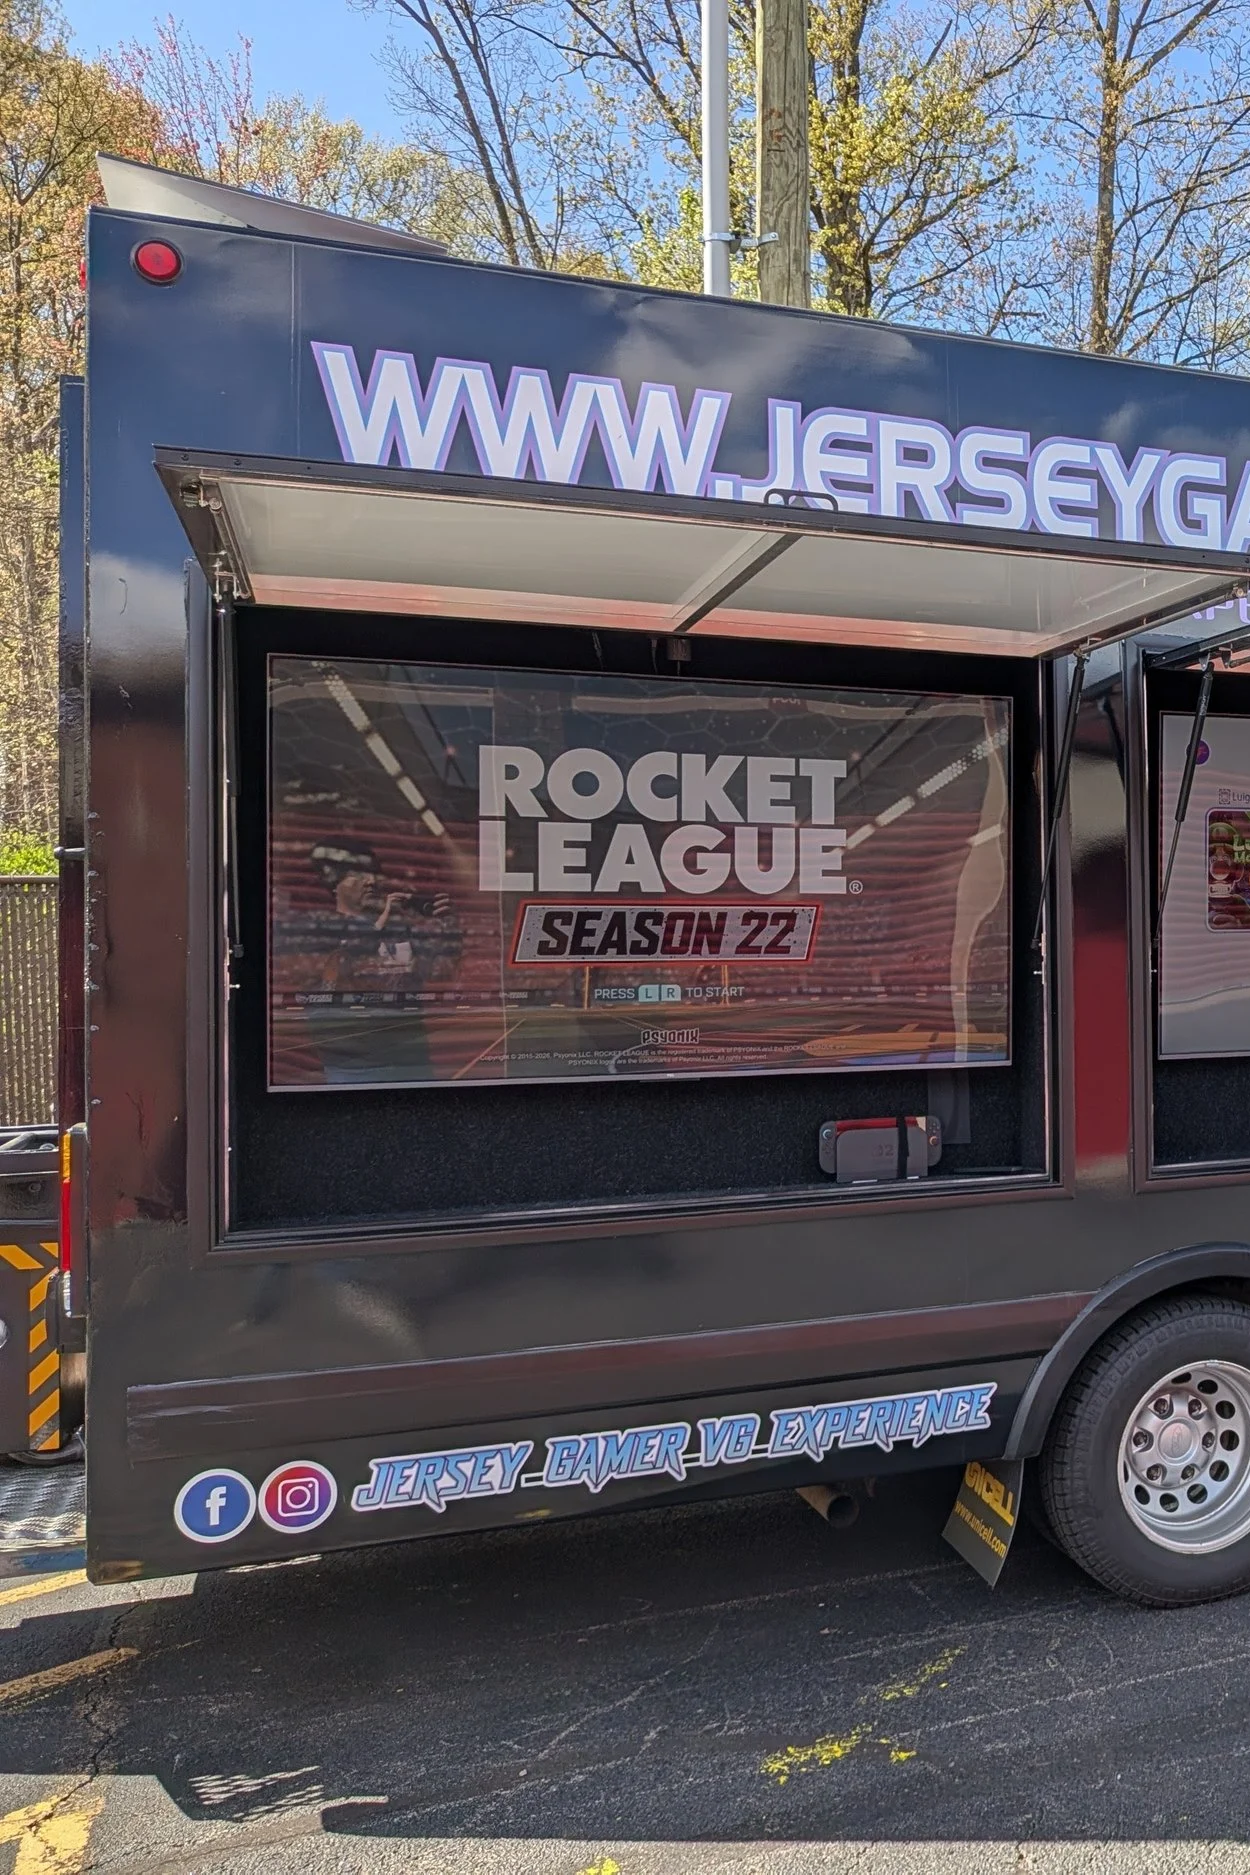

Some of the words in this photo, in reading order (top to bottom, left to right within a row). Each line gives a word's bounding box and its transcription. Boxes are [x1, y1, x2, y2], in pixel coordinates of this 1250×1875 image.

[479, 745, 847, 825] ROCKET
[537, 910, 727, 957] SEASON
[734, 910, 798, 956] 22
[594, 988, 635, 1000] PRESS
[645, 988, 653, 999] L
[666, 987, 676, 999] R
[685, 987, 703, 998] TO
[705, 986, 746, 999] START
[954, 1500, 1008, 1558] www.unicell.com
